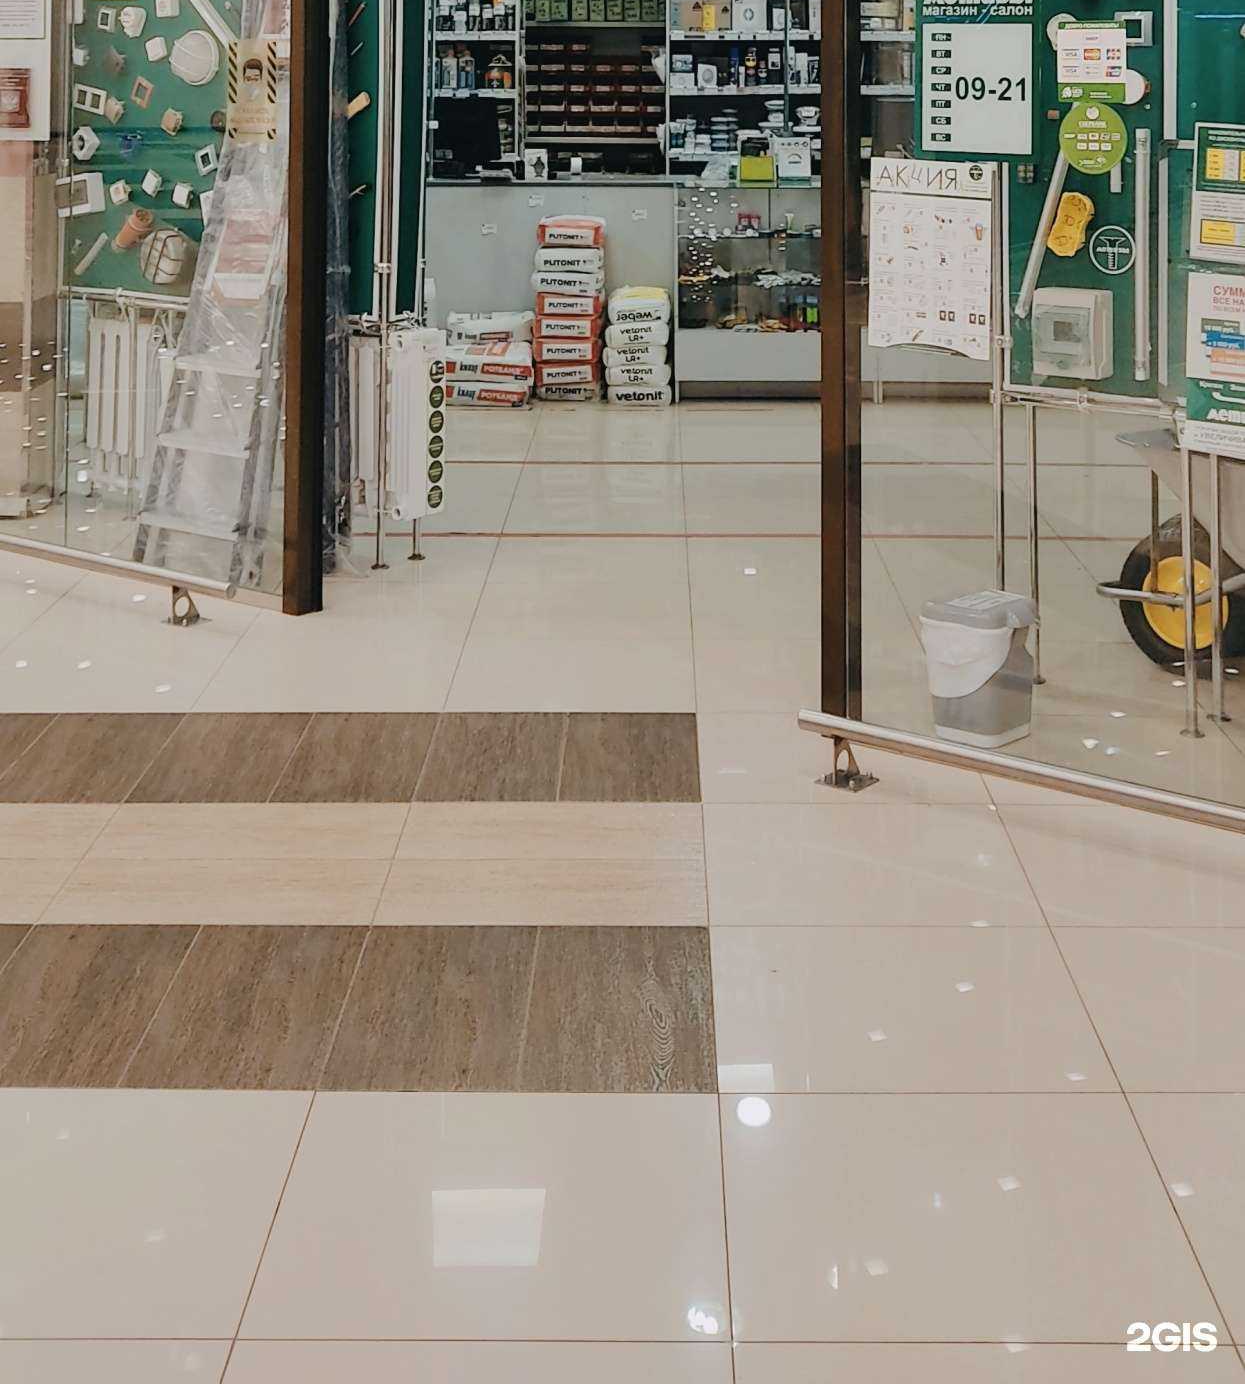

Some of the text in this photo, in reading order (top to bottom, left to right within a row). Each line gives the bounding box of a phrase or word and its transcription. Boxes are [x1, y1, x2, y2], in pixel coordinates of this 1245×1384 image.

[923, 5, 978, 16] магазин
[989, 5, 1033, 16] салон
[955, 77, 1026, 101] 09-21
[620, 327, 652, 335] vetonit
[617, 347, 649, 355] vetonit
[620, 367, 653, 375] vetonit
[616, 391, 664, 401] vetonit
